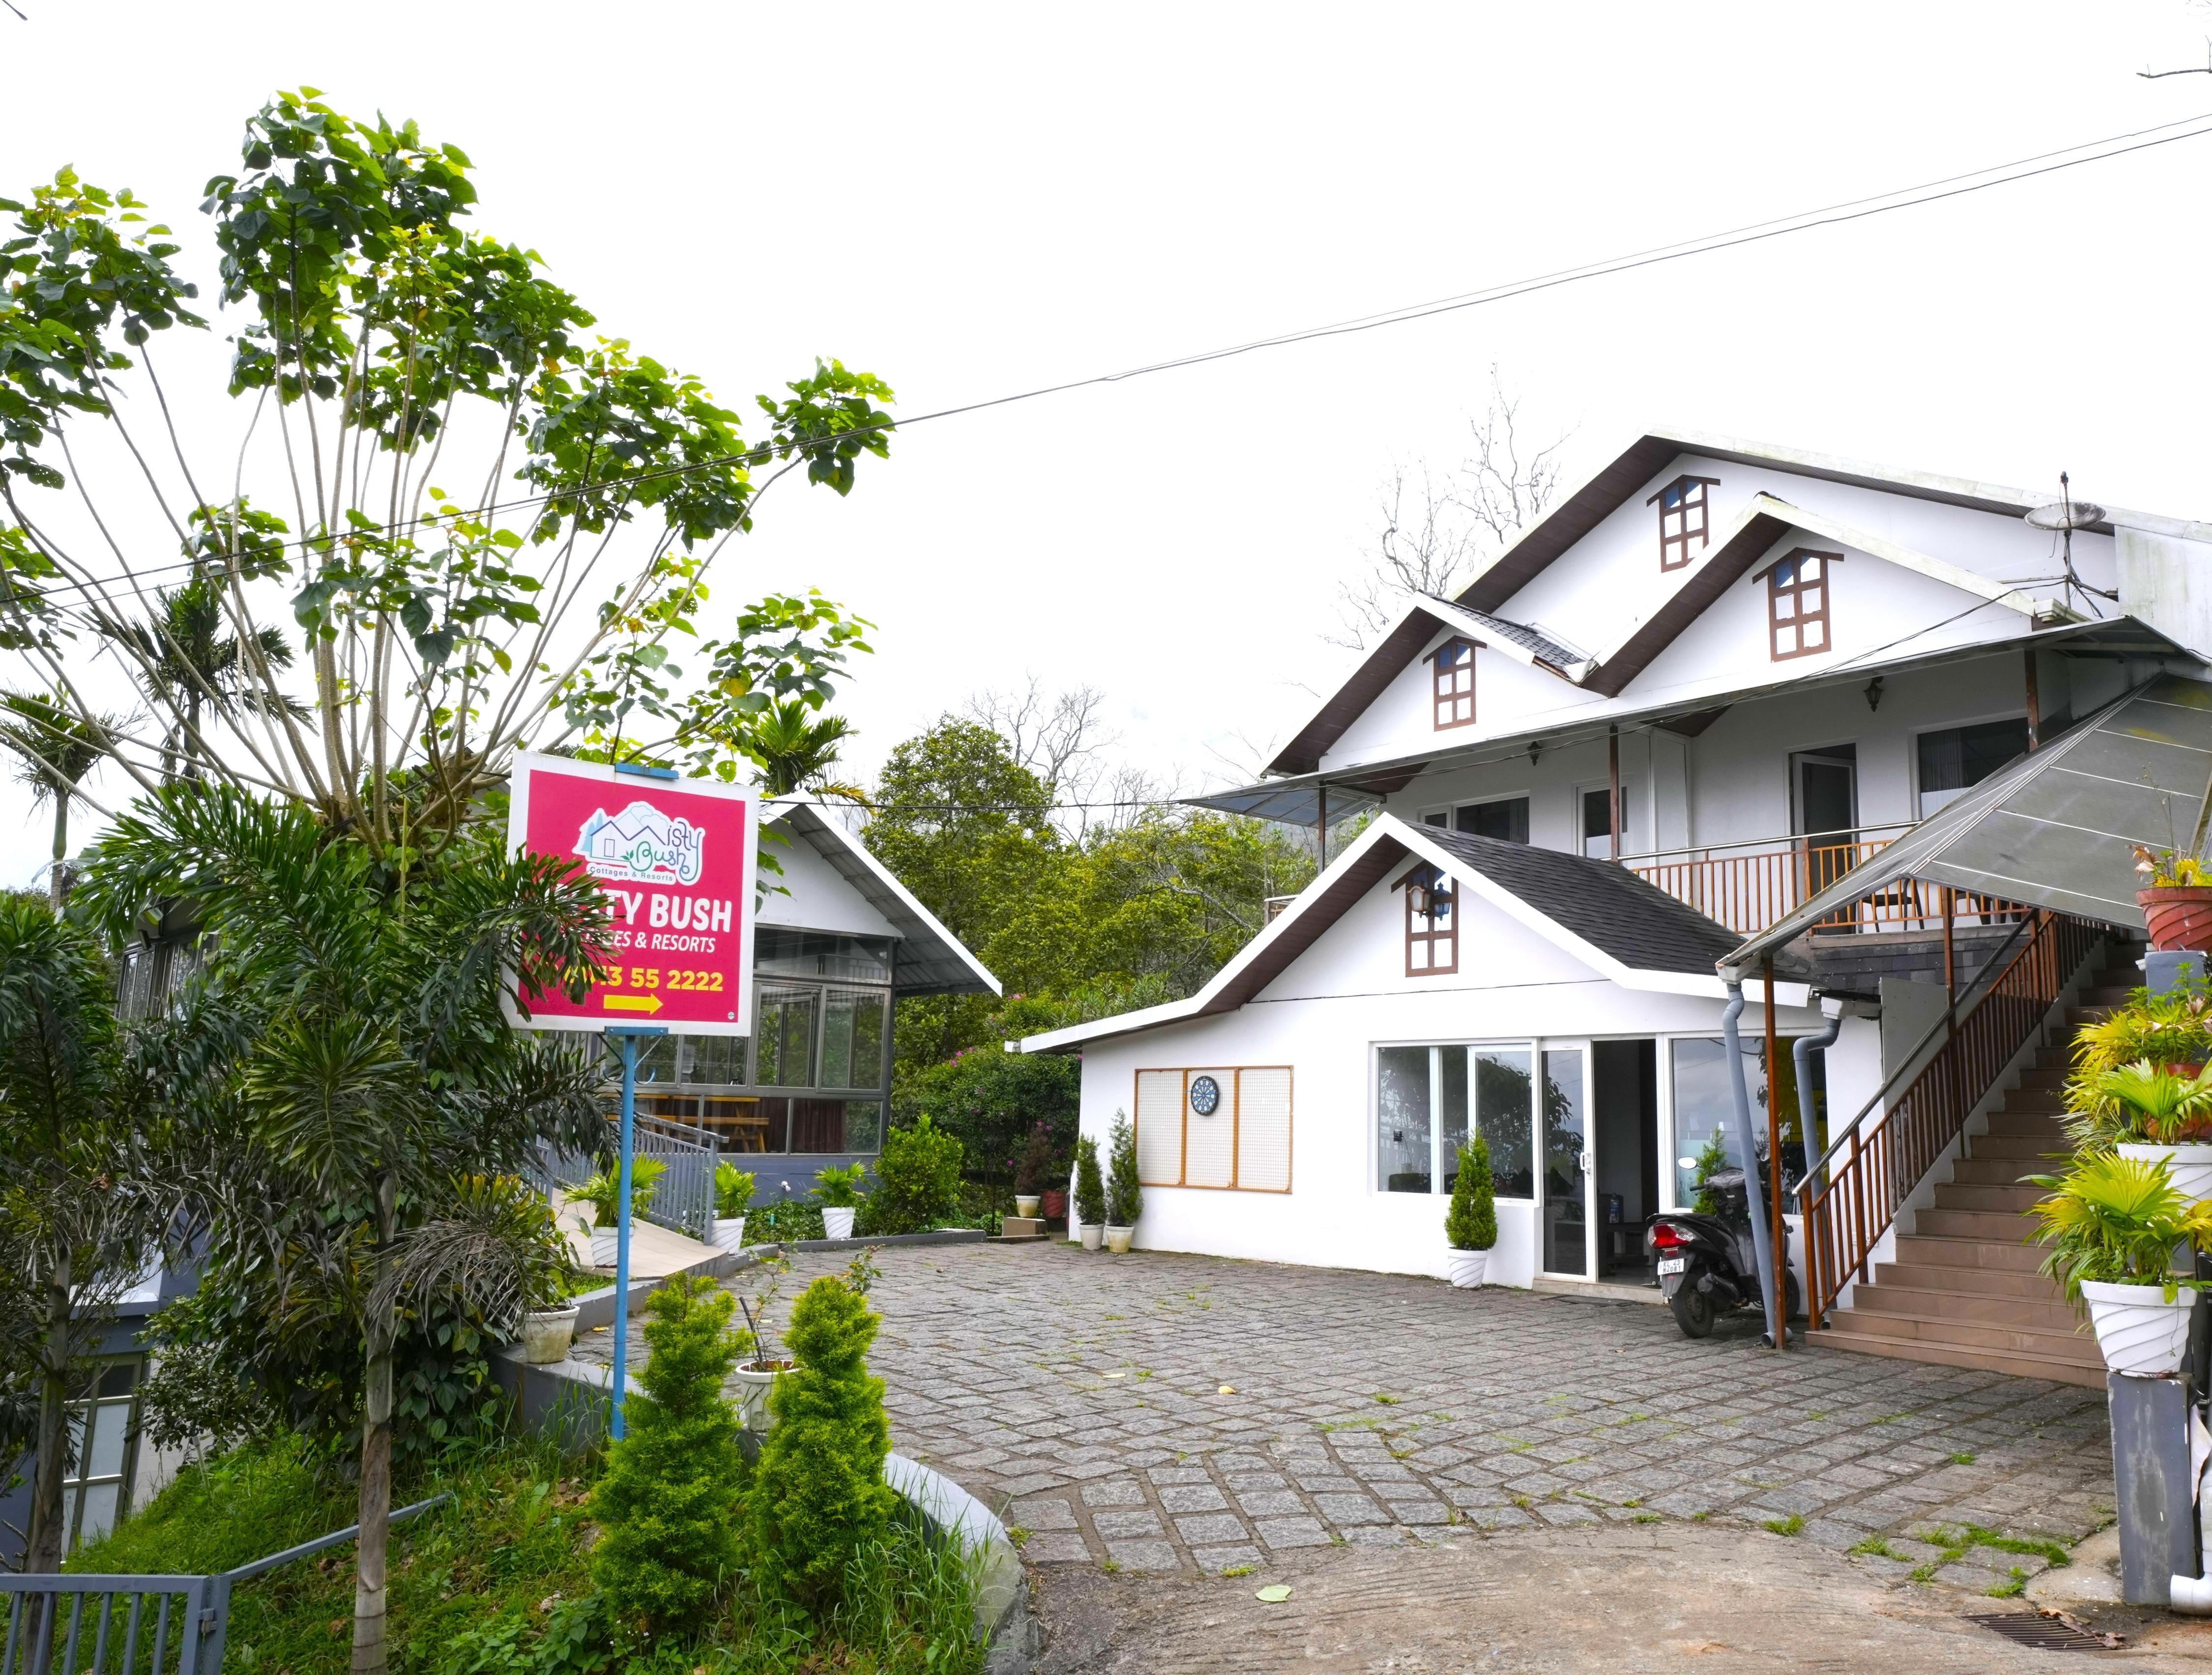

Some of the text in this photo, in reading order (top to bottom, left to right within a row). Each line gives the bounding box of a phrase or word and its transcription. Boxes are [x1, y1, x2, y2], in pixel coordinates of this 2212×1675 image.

[630, 841, 690, 874] Bush
[590, 866, 628, 877] Cottages
[641, 872, 673, 882] Resorts
[649, 893, 732, 933] BUSH
[635, 932, 647, 948] &
[651, 934, 716, 953] RESORTS
[630, 968, 659, 989] 55
[667, 970, 723, 992] 2222
